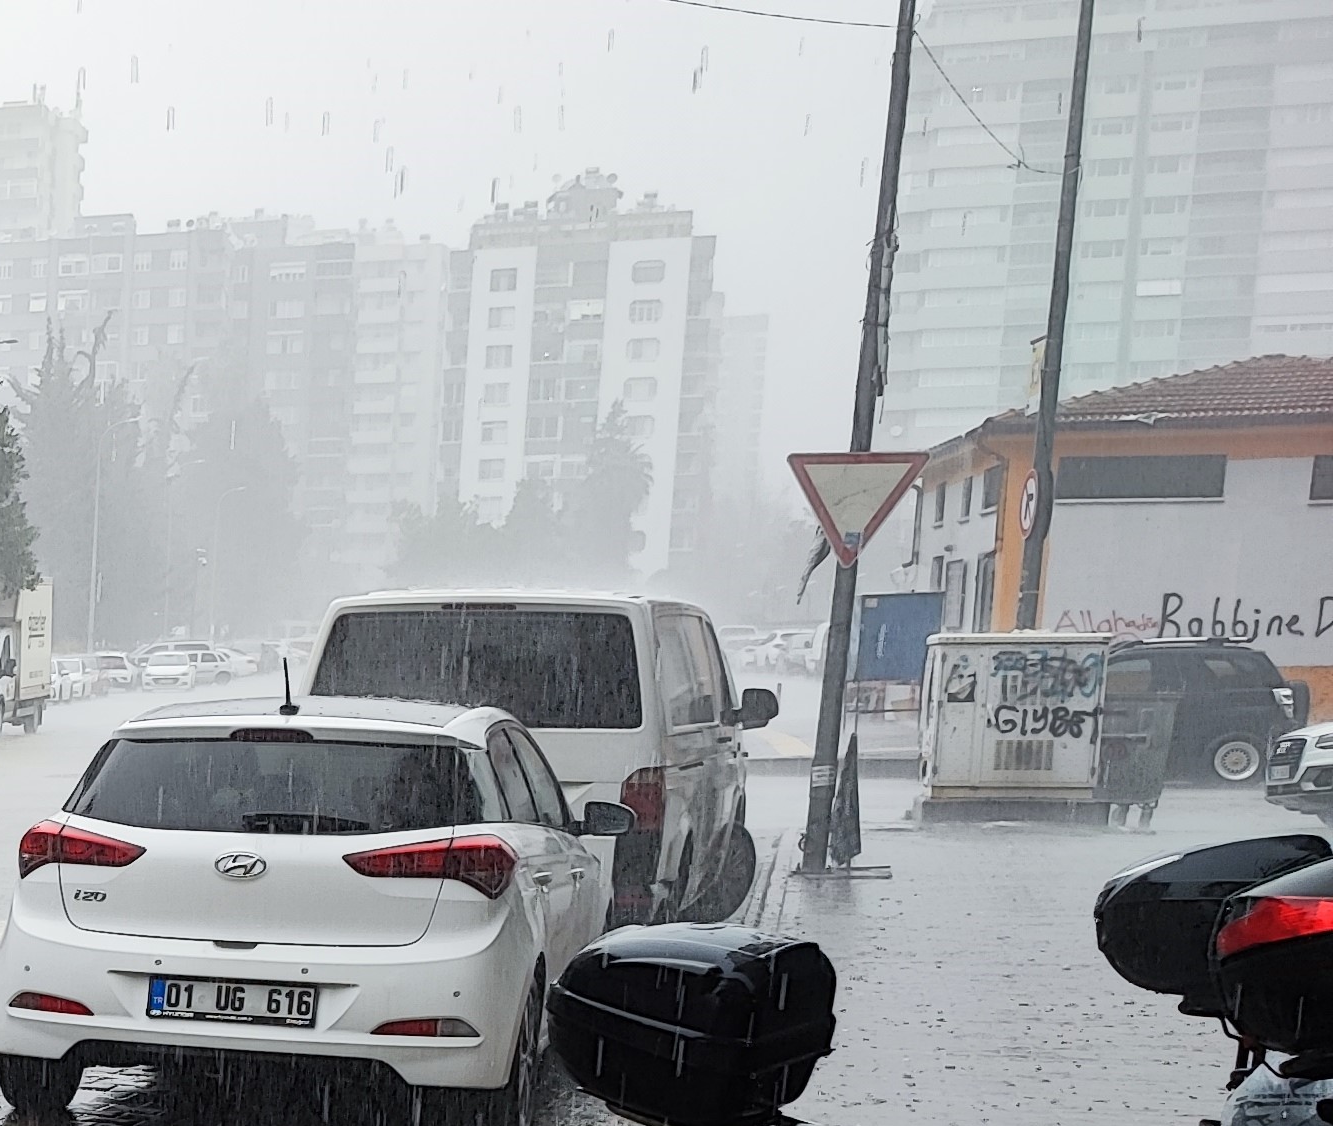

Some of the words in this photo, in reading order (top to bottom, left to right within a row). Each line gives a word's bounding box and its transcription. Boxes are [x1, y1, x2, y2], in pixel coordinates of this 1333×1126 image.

[166, 983, 194, 1009] 01
[215, 985, 246, 1012] UG
[267, 988, 312, 1016] 616
